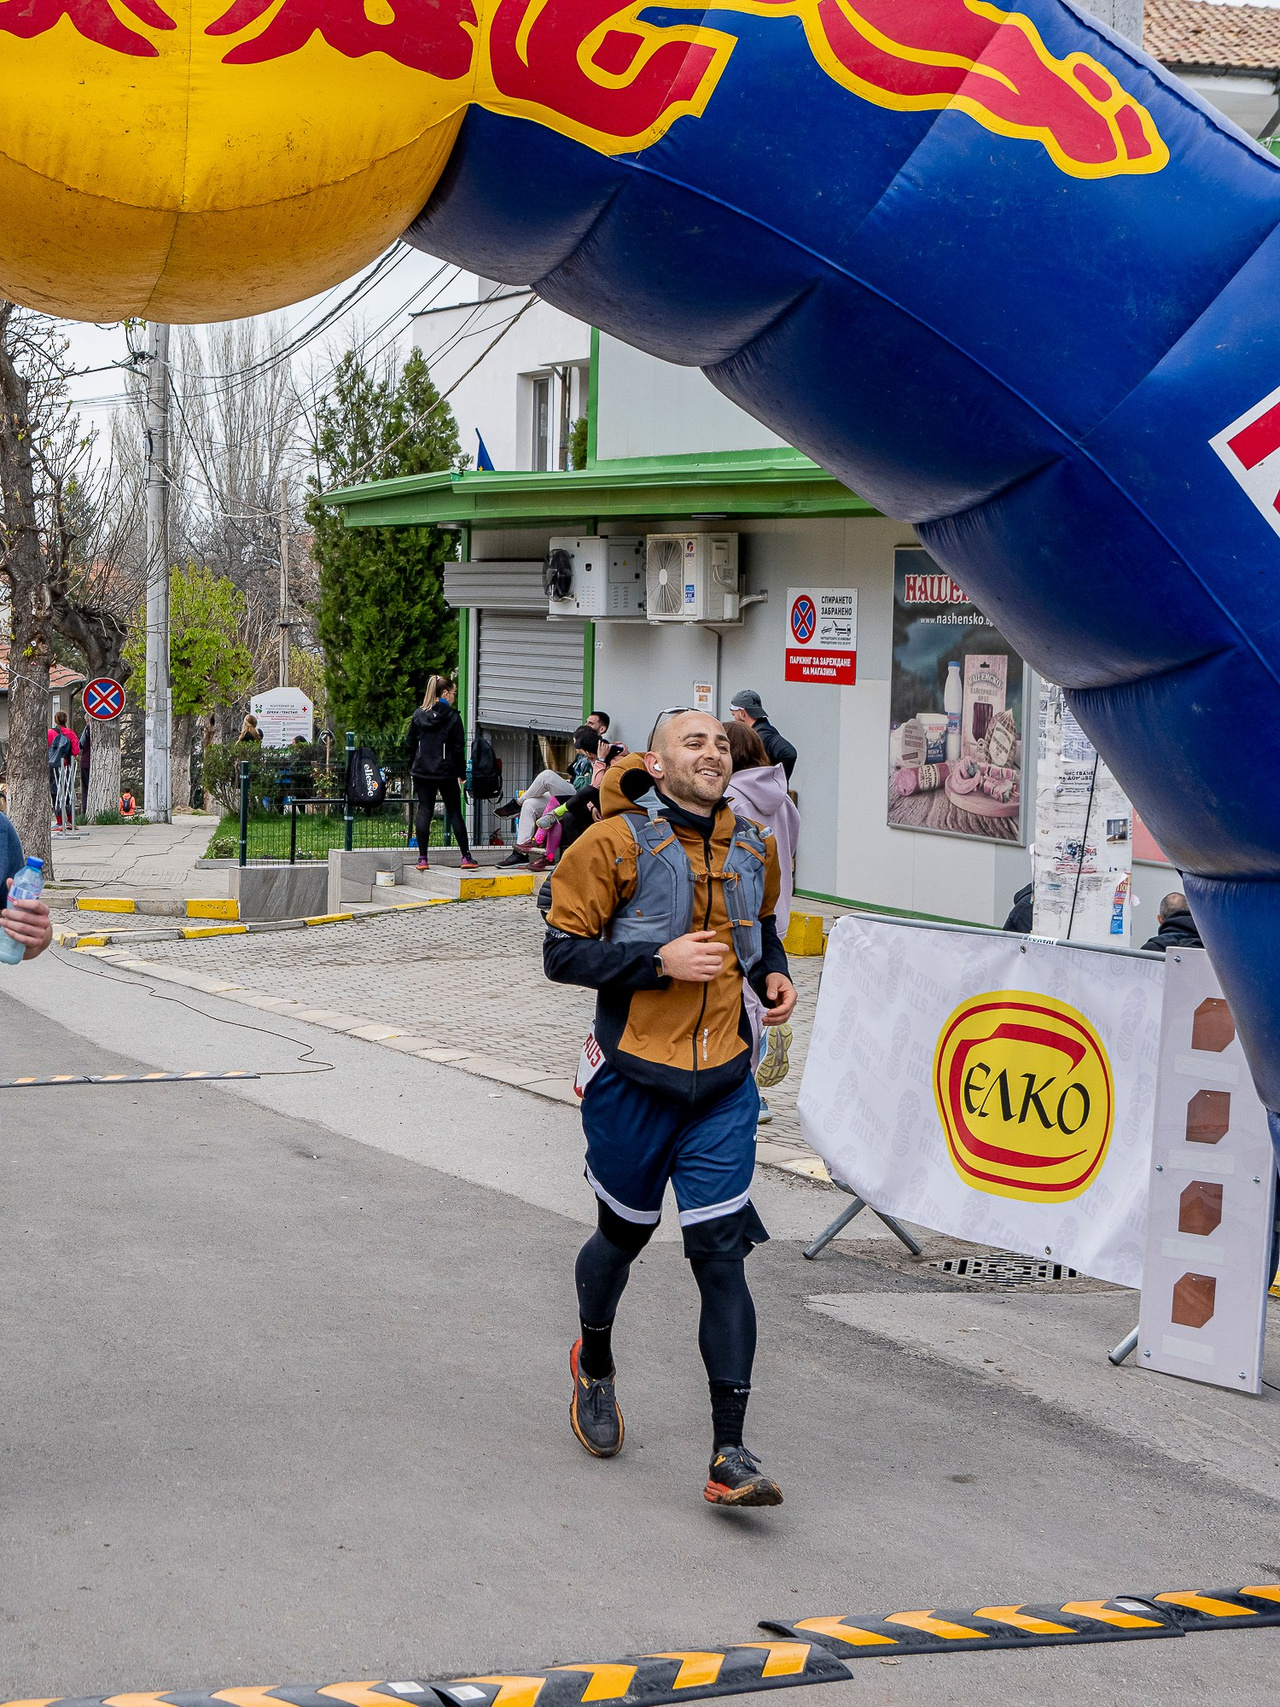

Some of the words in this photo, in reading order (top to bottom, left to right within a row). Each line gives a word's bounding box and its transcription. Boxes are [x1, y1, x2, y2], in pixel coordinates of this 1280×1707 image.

[821, 607, 852, 616] ЗАБРАНЕНО
[789, 655, 812, 665] ПАРКИНГ
[813, 656, 819, 665] ЗА
[802, 667, 810, 675] НА
[810, 667, 837, 676] МАГАЗИНА
[364, 763, 374, 797] ellesse
